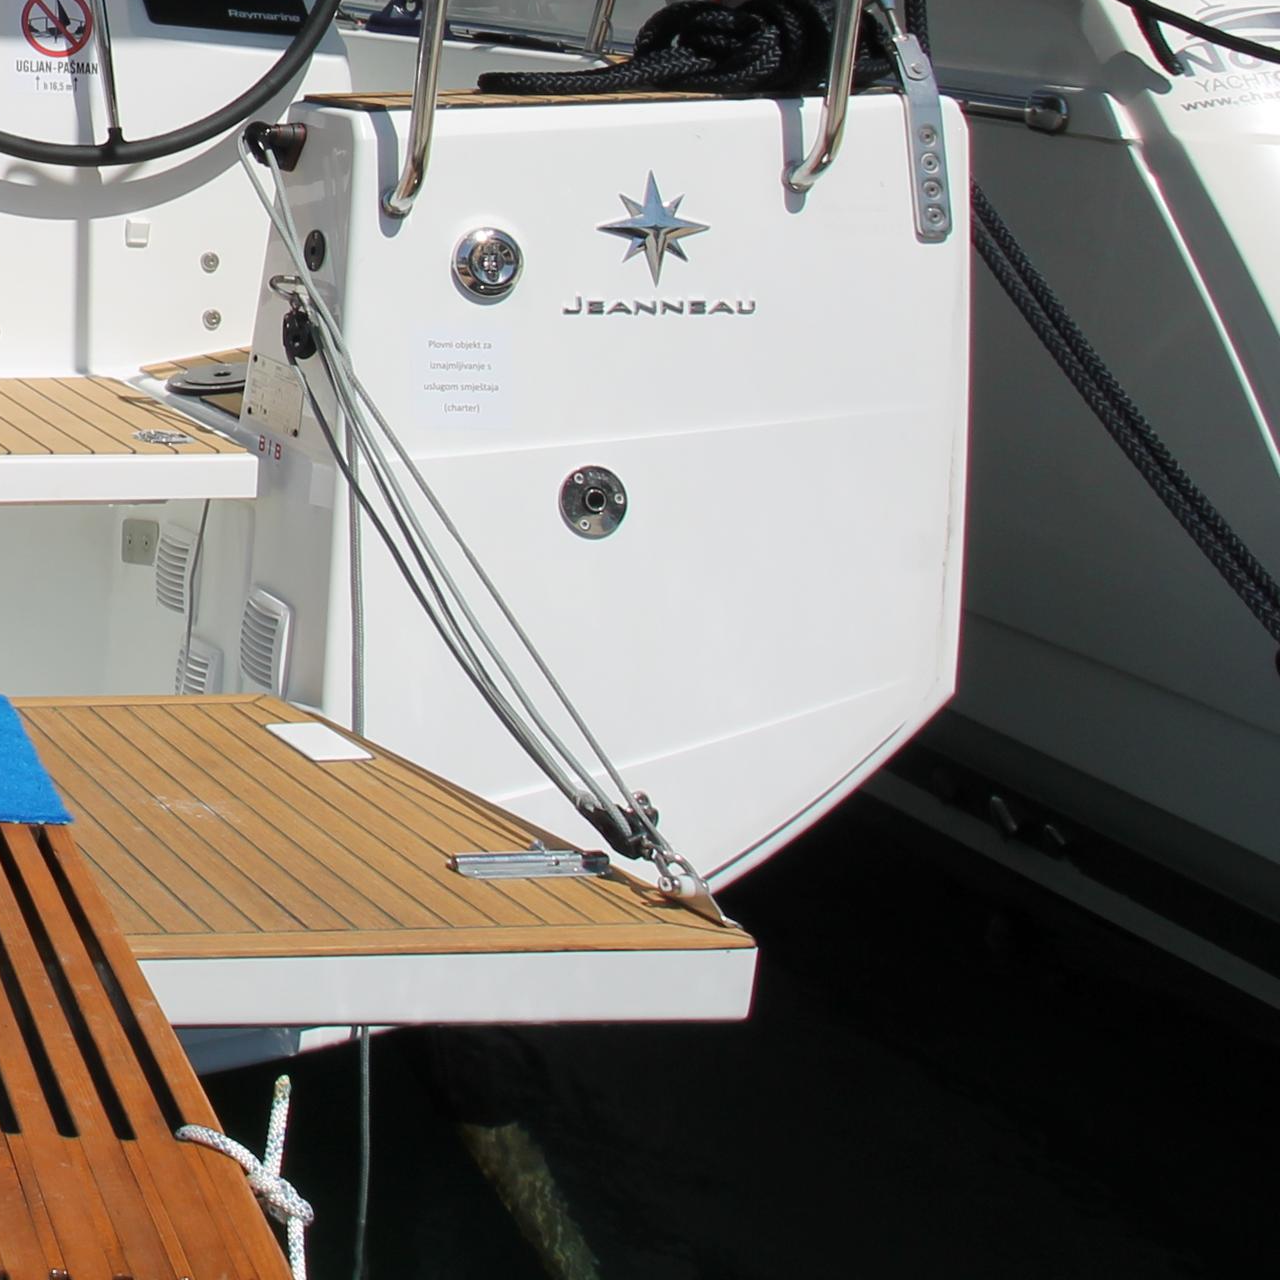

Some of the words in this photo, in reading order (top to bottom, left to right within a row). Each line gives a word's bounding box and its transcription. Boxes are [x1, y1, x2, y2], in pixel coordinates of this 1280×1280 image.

[227, 8, 301, 23] Raymarine
[15, 60, 99, 75] UGLJAN-PAŠMAN
[562, 295, 756, 316] JEANNEAU
[427, 339, 453, 349] Plovni
[454, 339, 481, 350] objekt
[429, 361, 486, 371] iznajmljivanje
[423, 382, 459, 392] uslugom
[460, 382, 500, 393] smještaja
[443, 403, 481, 413] (charter)
